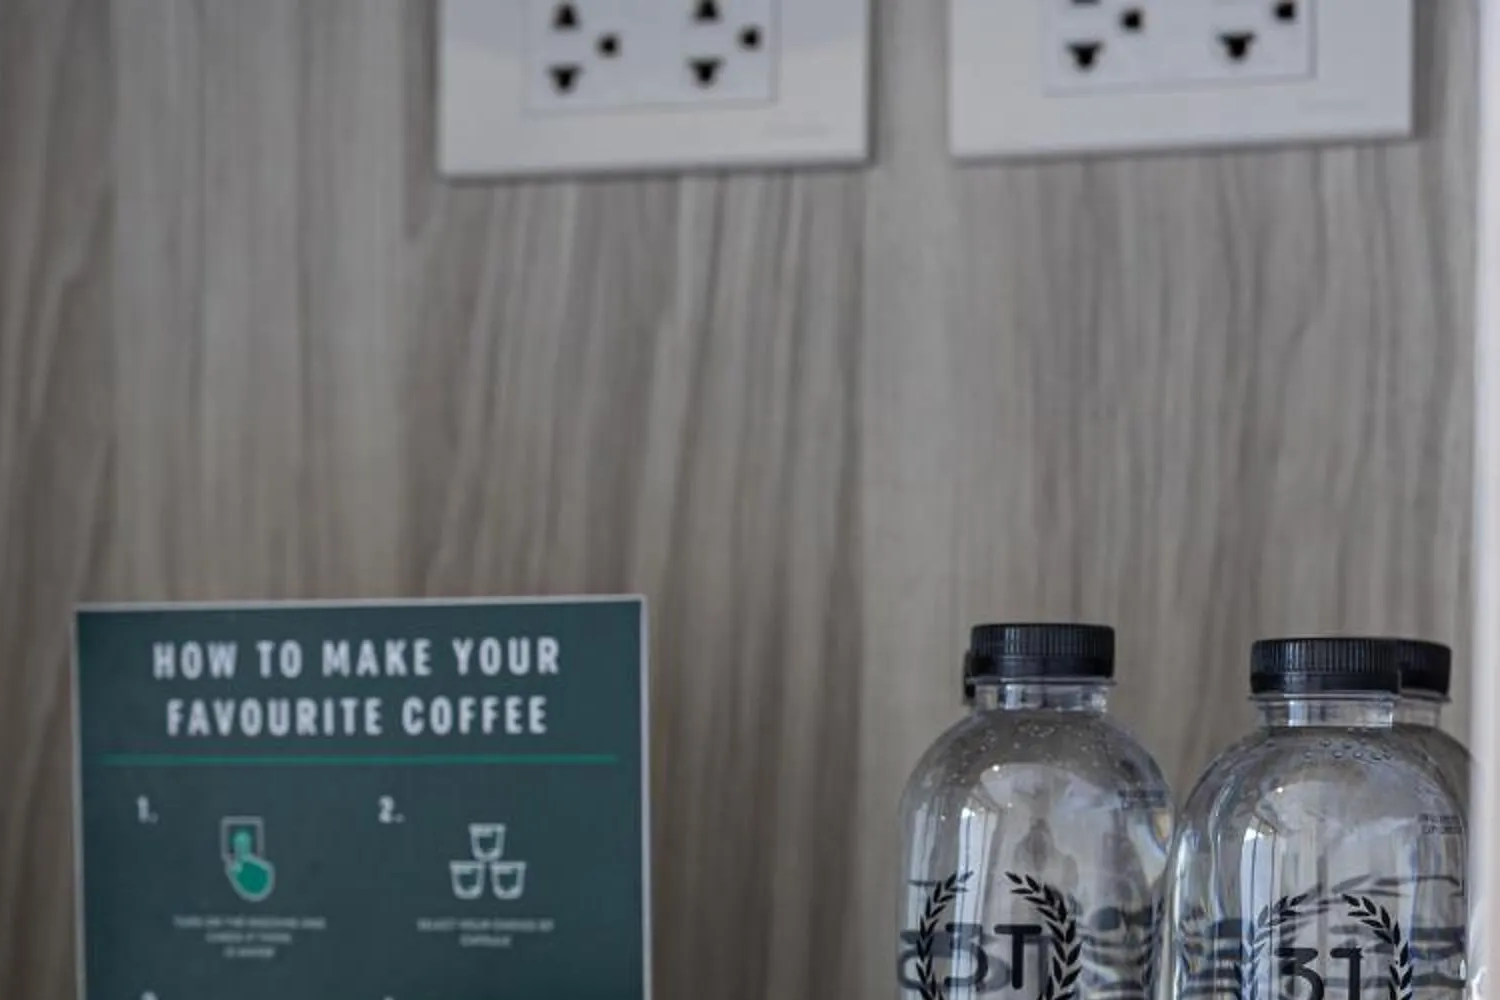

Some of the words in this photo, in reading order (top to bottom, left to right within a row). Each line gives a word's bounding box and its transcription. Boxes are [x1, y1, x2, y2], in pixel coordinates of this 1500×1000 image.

[152, 640, 238, 680] HOW
[256, 640, 302, 679] TO
[321, 639, 432, 678] MAKE
[451, 637, 560, 676] YOUR
[166, 698, 383, 737] FAVOURITE
[402, 696, 548, 735] COFFEE
[137, 795, 159, 824] 1.
[378, 795, 406, 824] 2.
